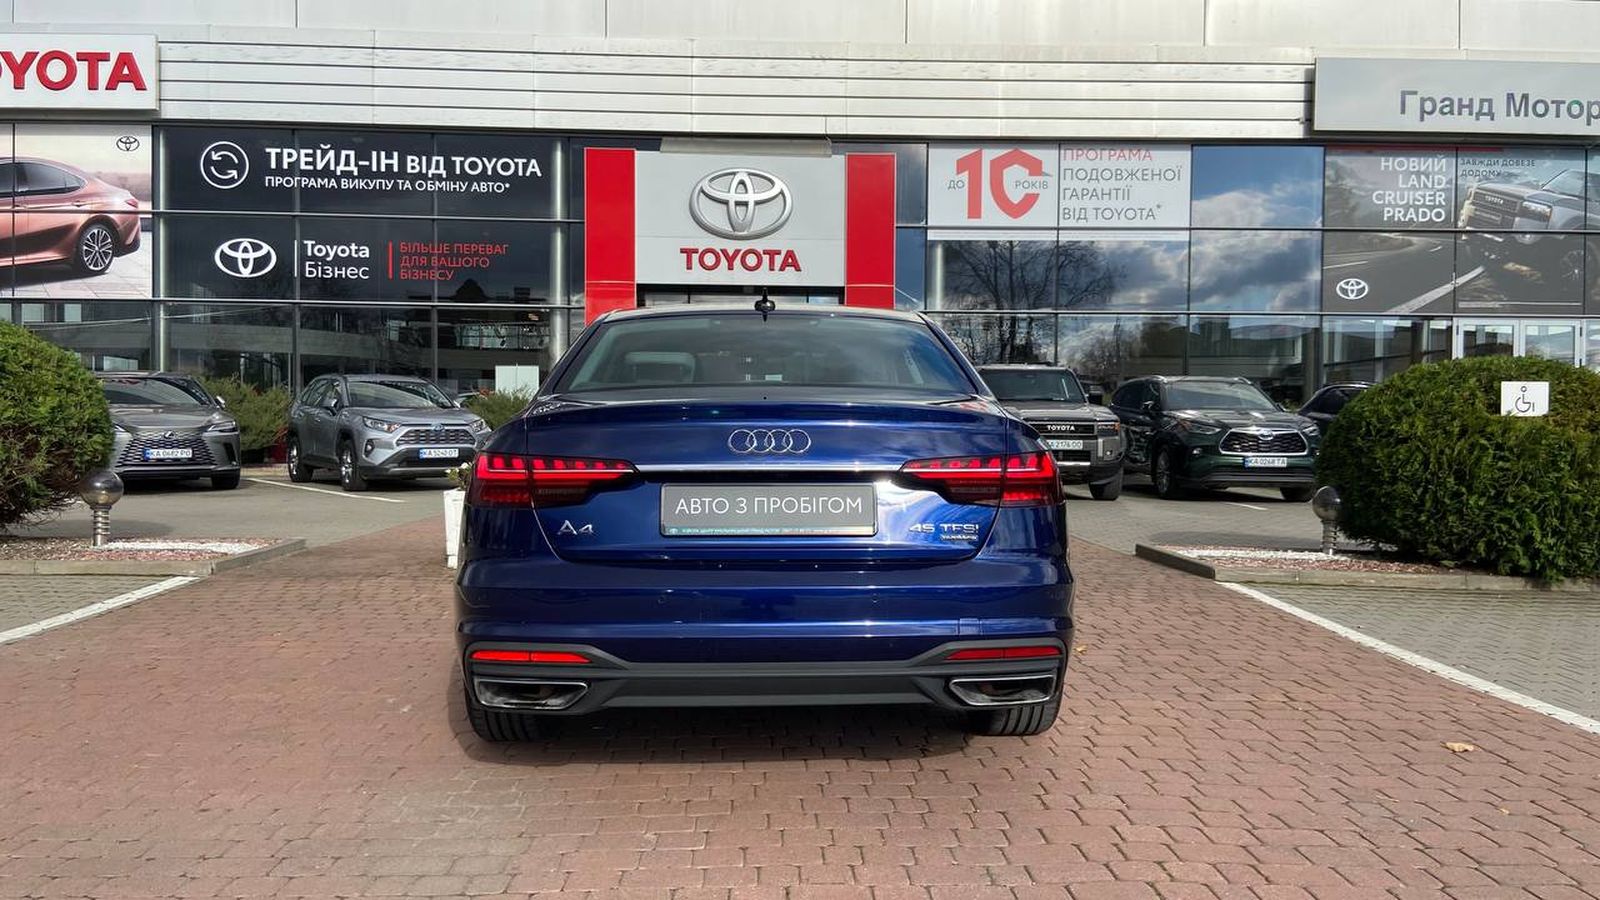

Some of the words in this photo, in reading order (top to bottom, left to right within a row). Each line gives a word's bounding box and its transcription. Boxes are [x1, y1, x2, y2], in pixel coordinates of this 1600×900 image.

[0, 50, 147, 91] YOTA
[1400, 90, 1495, 122] Гранд
[265, 144, 399, 176] ТРЕЙД-ІН
[406, 155, 447, 178] ВІД
[451, 156, 542, 177] TOYOTA
[1064, 148, 1153, 161] ПРОГРАМА
[1380, 155, 1446, 172] НОВИЙ
[1460, 159, 1499, 167] ЗАВЖДИ
[1501, 159, 1535, 167] ДОВЕЗЕ
[1064, 165, 1182, 183] ПОДОВЖЕНОЇ
[1399, 174, 1446, 189] LAND
[265, 176, 338, 189] ПРОГРАМА
[341, 179, 394, 190] ВИКУПУ
[397, 180, 413, 191] ТА
[415, 180, 469, 192] ОБМІНУ
[948, 180, 965, 189] ДО
[1015, 180, 1049, 190] РОКІВ
[1063, 185, 1133, 201] ГАРАНТІЇ
[1372, 191, 1446, 206] CRUISER
[1062, 207, 1088, 222] ВІД
[1383, 208, 1446, 222] PRADO
[303, 240, 370, 261] Toyota
[400, 241, 450, 254] БІЛЬШЕ
[454, 243, 508, 255] ПЕРЕВАГ
[400, 256, 428, 268] ДЛЯ
[431, 256, 490, 268] ВАШОГО
[680, 247, 802, 272] TOYOTA
[305, 261, 370, 280] Бізнес
[400, 269, 455, 281] БІЗНЕСУ
[675, 498, 729, 514] АВТО
[754, 497, 862, 514] ПРОБІГОМ
[557, 520, 594, 535] A4
[909, 523, 935, 532] 45
[939, 524, 979, 533] TFSI
